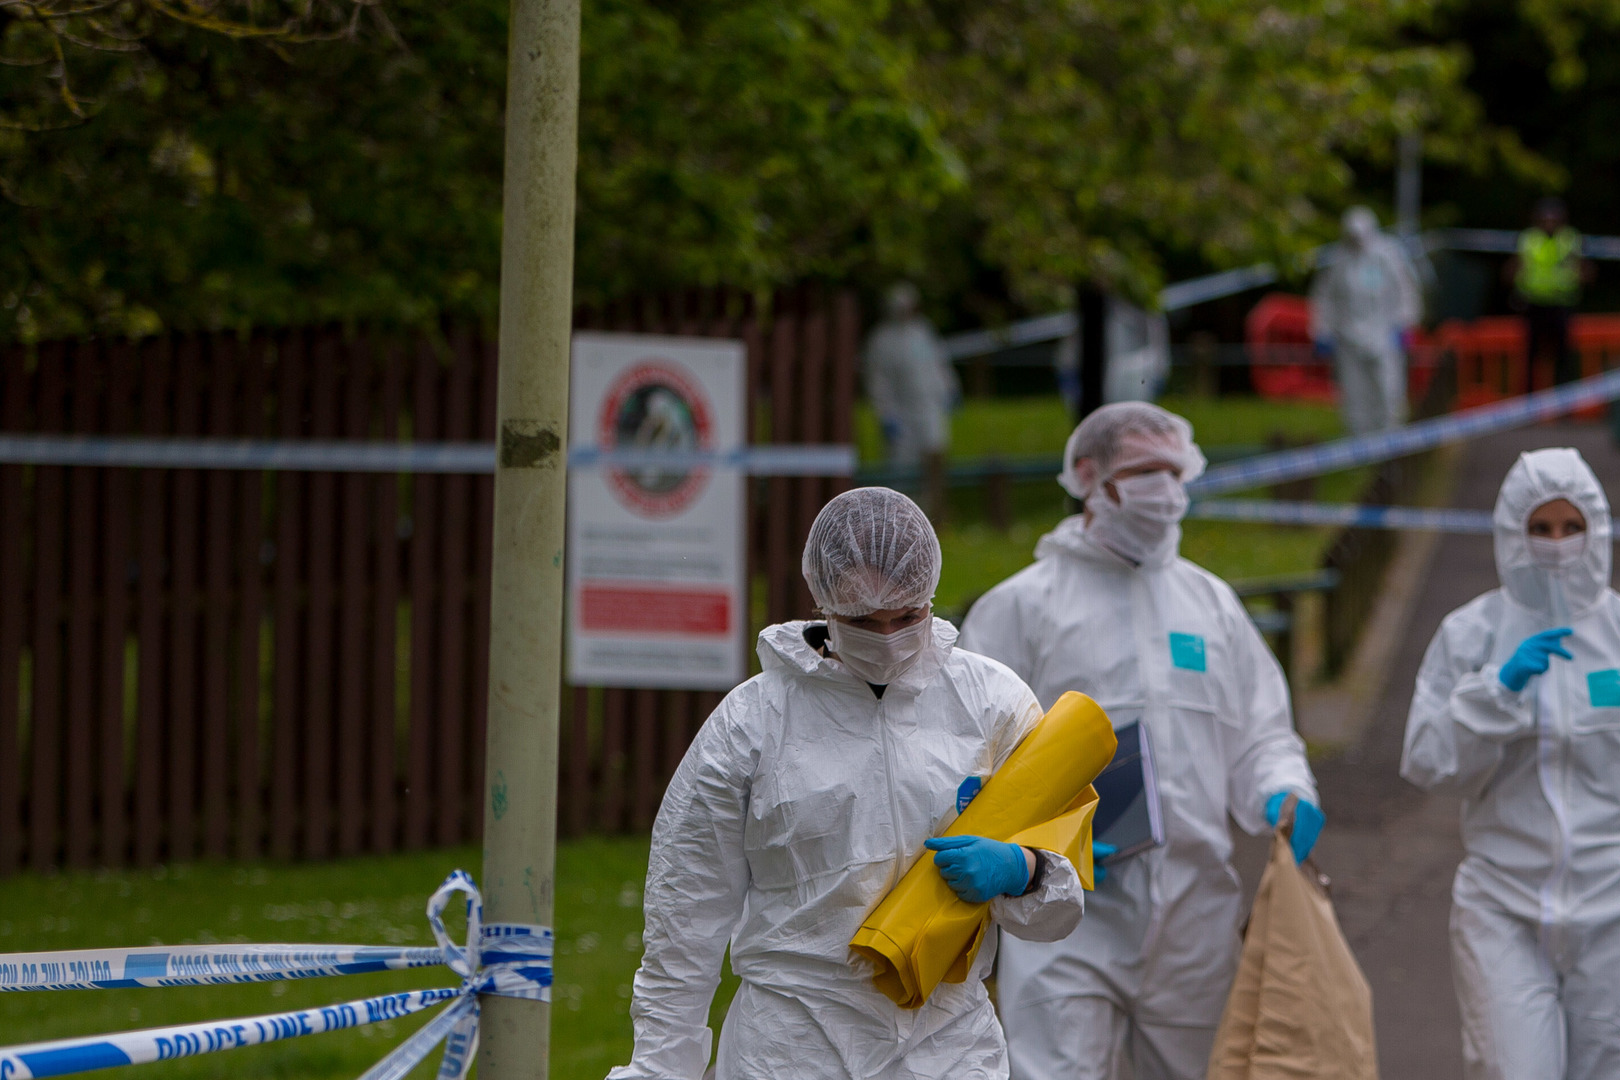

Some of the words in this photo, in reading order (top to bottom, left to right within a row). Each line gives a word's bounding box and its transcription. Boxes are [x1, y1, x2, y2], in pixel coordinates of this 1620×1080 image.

[155, 1025, 248, 1061] POLICE
[254, 1013, 313, 1043] LINE
[364, 993, 411, 1023] NOT
